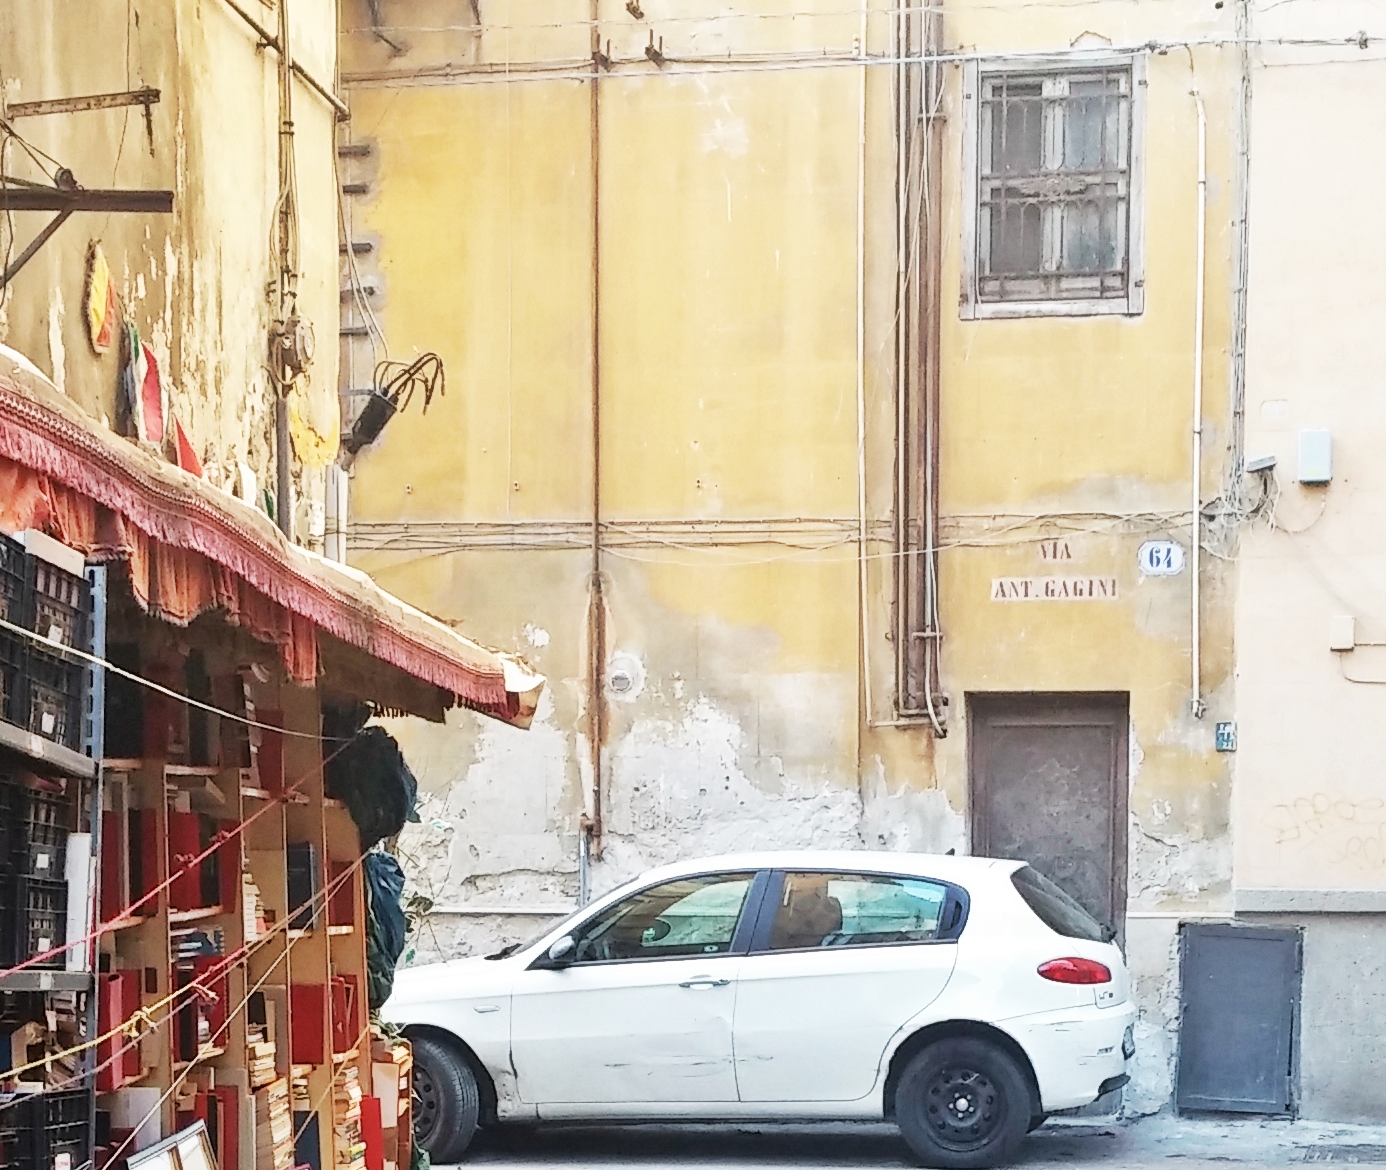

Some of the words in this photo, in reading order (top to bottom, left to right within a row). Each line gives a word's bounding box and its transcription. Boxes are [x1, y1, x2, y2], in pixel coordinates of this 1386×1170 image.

[1040, 542, 1072, 559] VIA
[1149, 547, 1172, 568] 64
[994, 580, 1040, 598] ANT.
[1044, 578, 1117, 598] GAGINI
